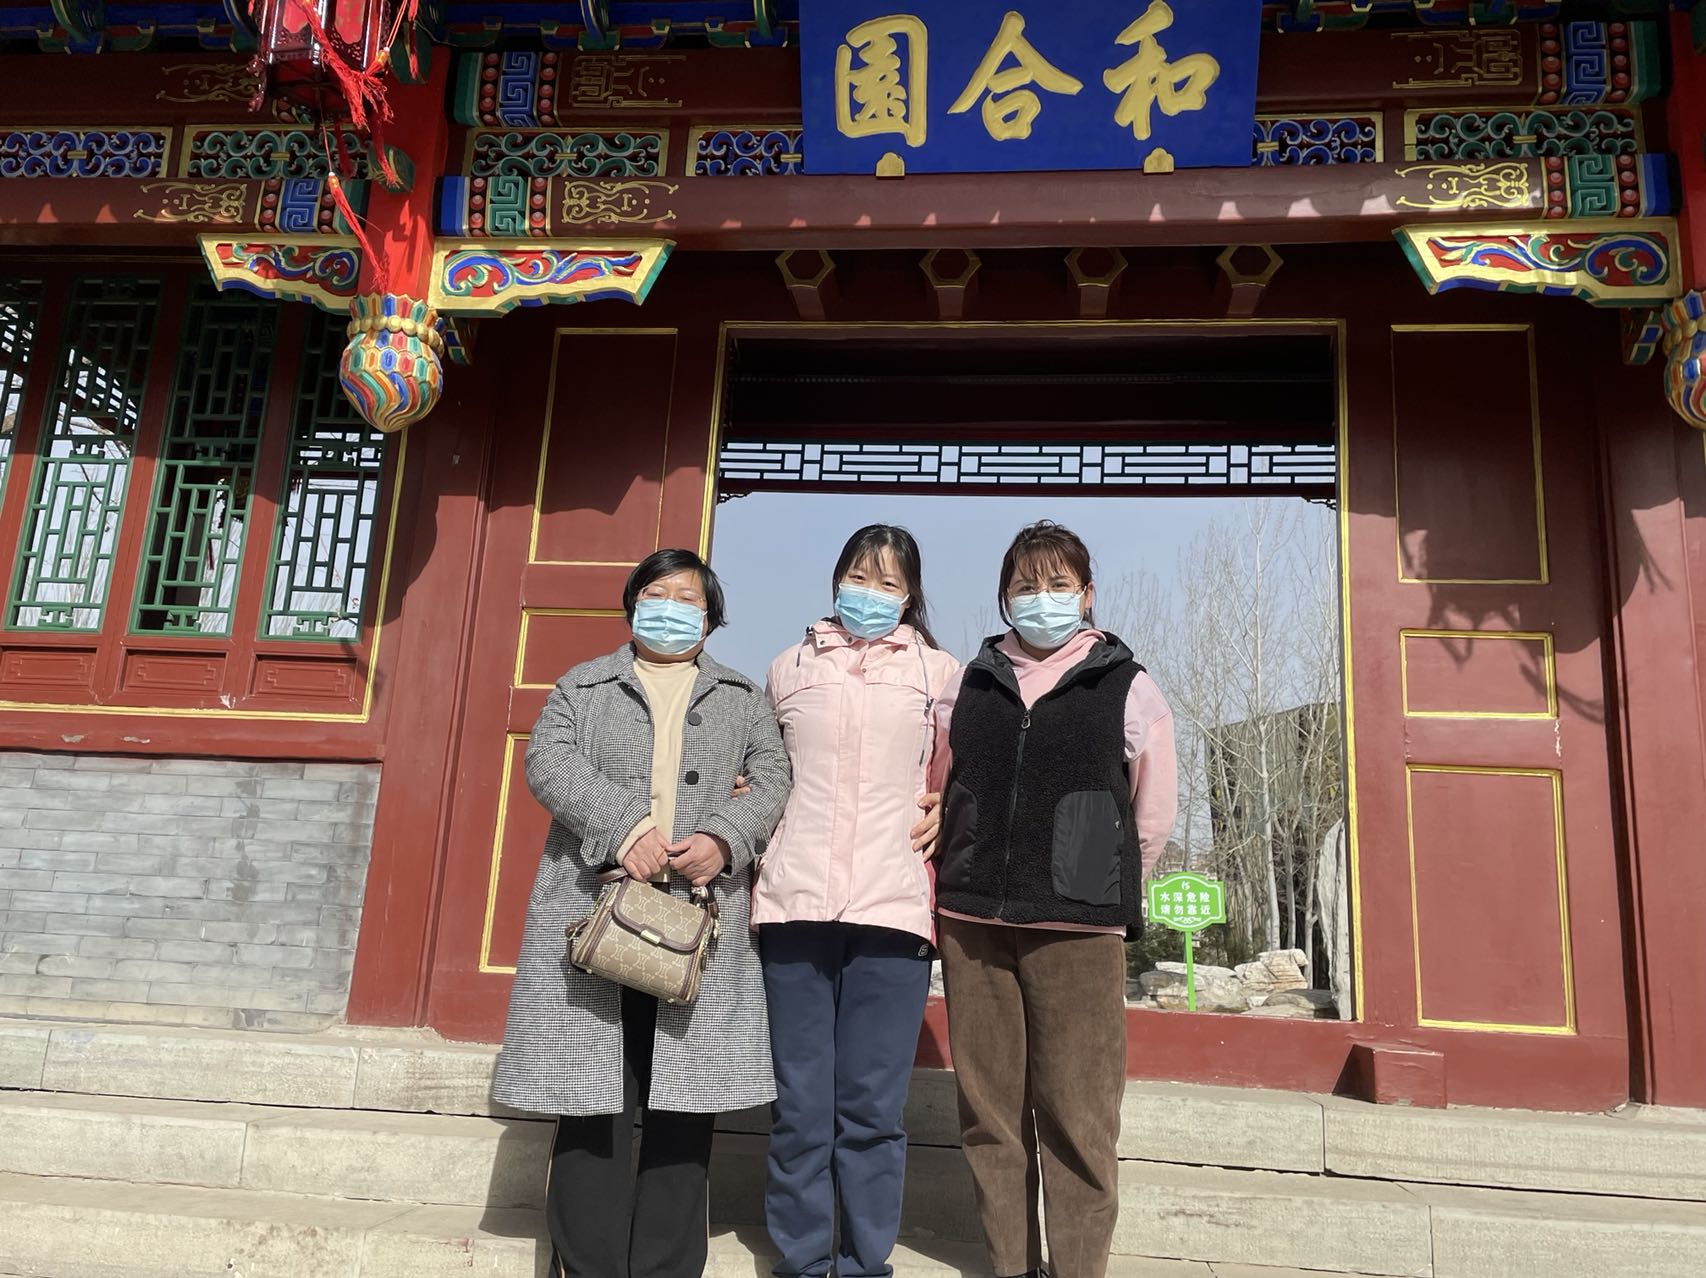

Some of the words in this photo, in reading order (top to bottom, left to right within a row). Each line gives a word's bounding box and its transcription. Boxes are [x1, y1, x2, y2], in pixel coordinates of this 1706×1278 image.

[1160, 892, 1210, 903] 水深危险
[1160, 904, 1211, 915] 请勿靠近
